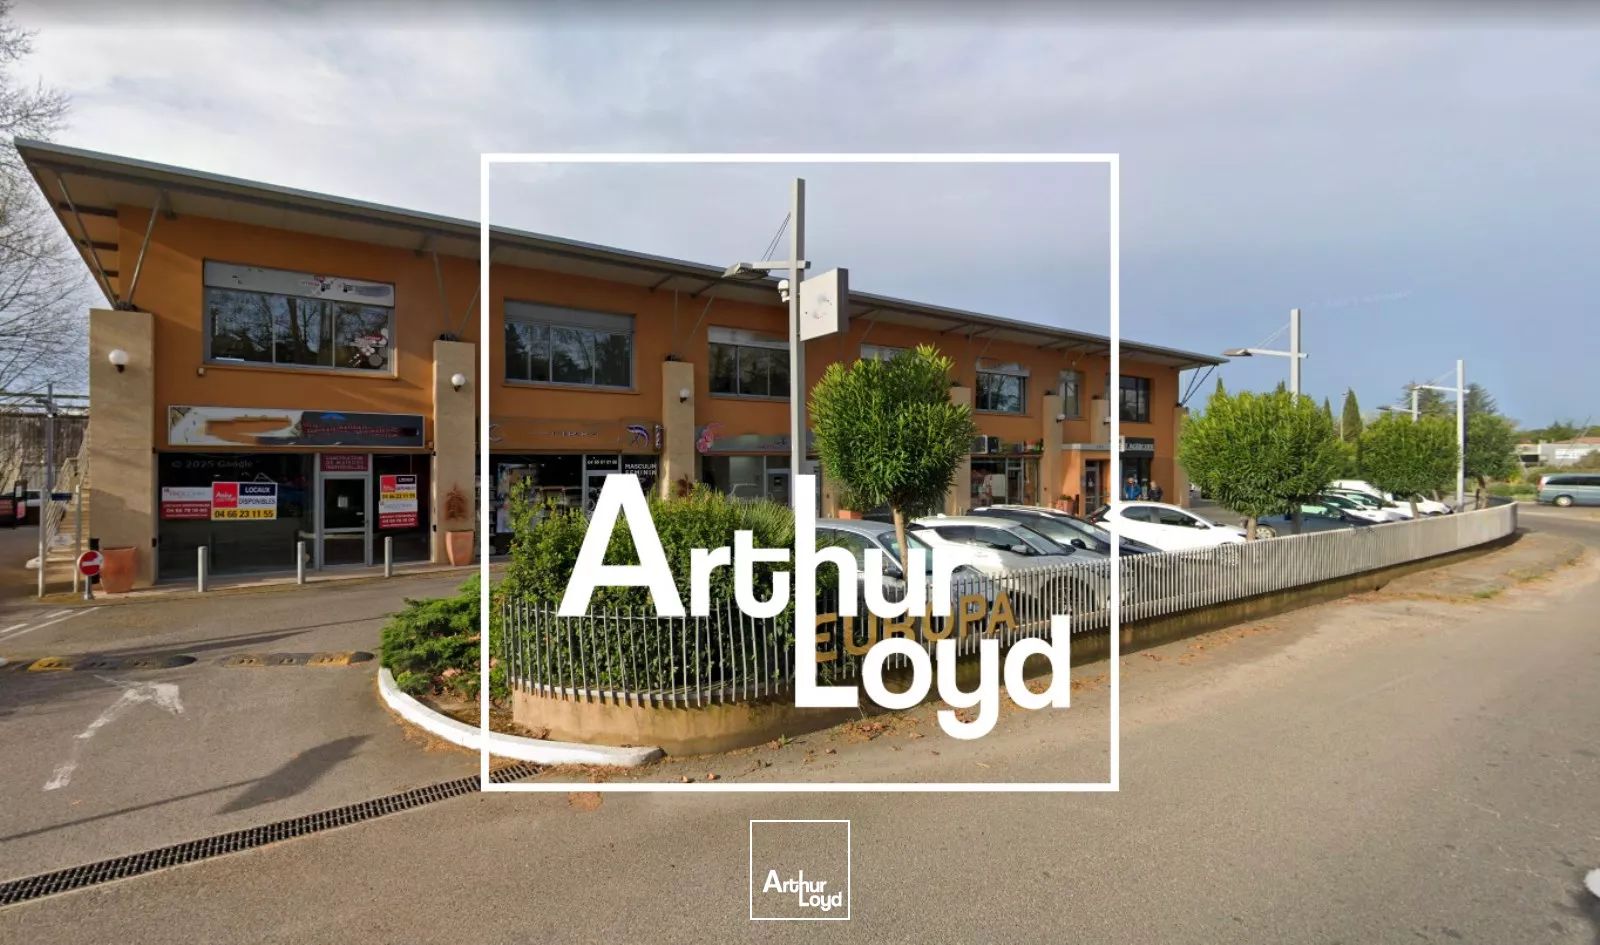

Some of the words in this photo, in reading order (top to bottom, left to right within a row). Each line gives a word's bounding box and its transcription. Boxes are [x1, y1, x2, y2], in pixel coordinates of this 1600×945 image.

[239, 497, 276, 505] DISPONIBLES
[214, 509, 224, 518] 04
[226, 509, 237, 518] 66
[239, 509, 249, 518] 23
[252, 509, 261, 518] 11
[263, 509, 274, 518] 55
[815, 592, 1017, 663] EUROPA
